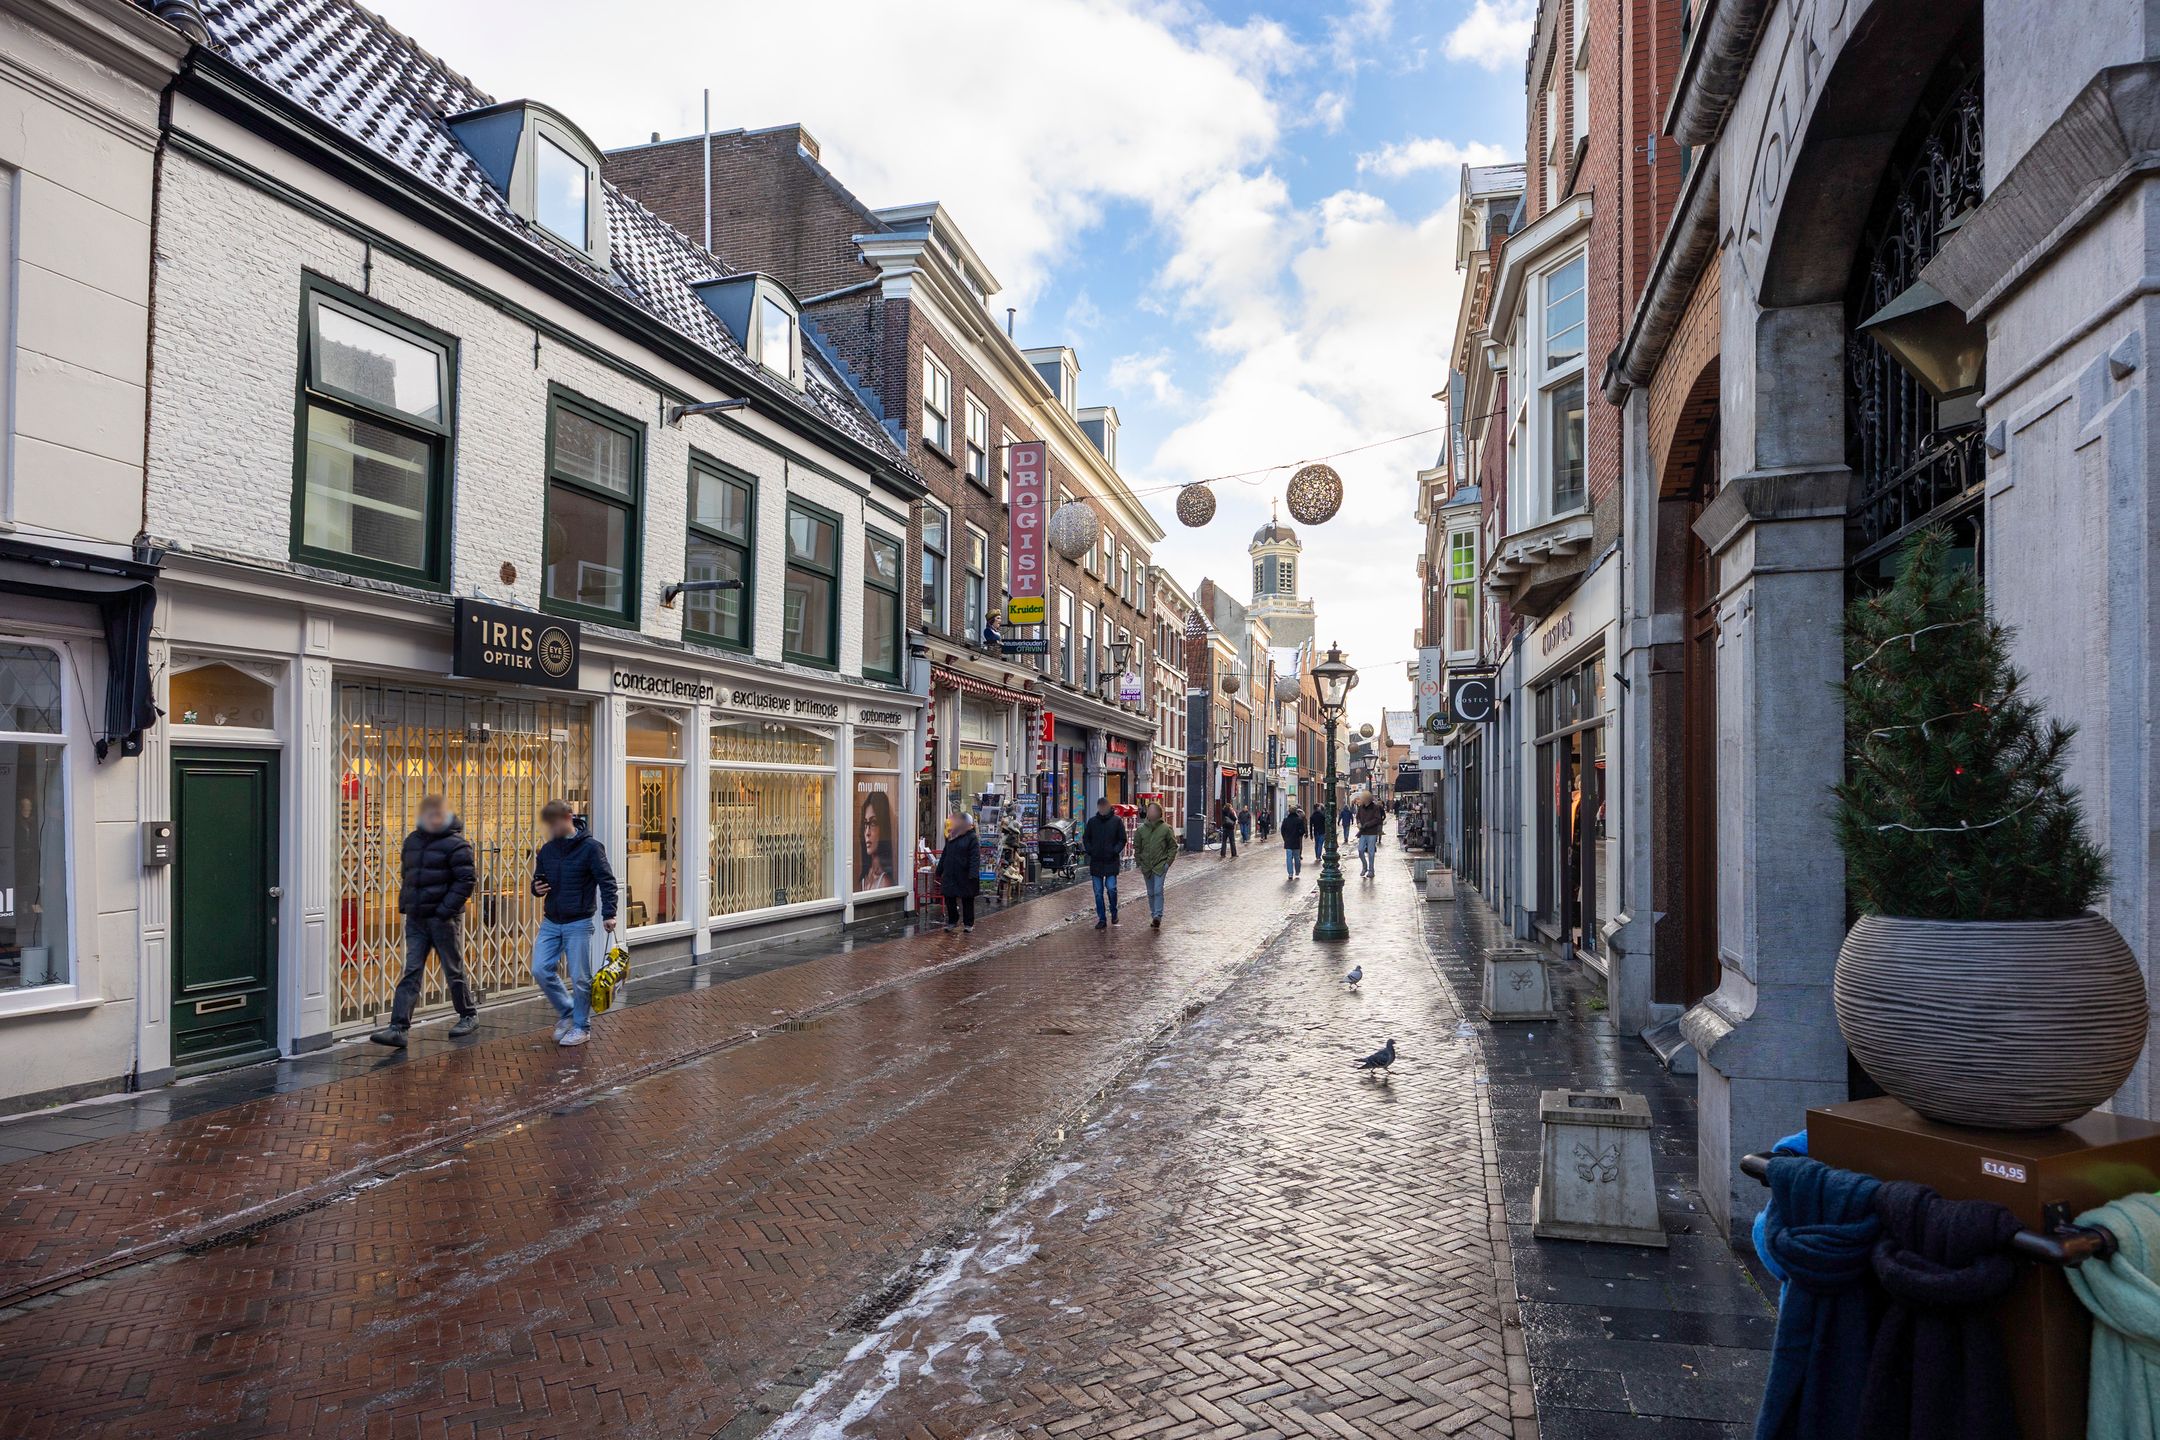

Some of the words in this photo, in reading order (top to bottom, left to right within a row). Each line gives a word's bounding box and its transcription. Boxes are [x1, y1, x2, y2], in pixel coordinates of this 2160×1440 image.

[1016, 451, 1038, 590] DROGIST
[1010, 605, 1043, 614] Kruiden
[482, 620, 533, 652] IRIS
[1542, 611, 1573, 656] COSTES
[483, 651, 532, 670] OPTIEK
[549, 647, 562, 655] EYE
[613, 671, 714, 700] contactlenzen
[733, 690, 791, 710] exclusieve
[795, 699, 839, 717] brilmode
[860, 709, 901, 725] optometrie
[857, 782, 873, 793] MIU
[874, 783, 888, 793] MIU
[1984, 1162, 2024, 1180] €14,95
